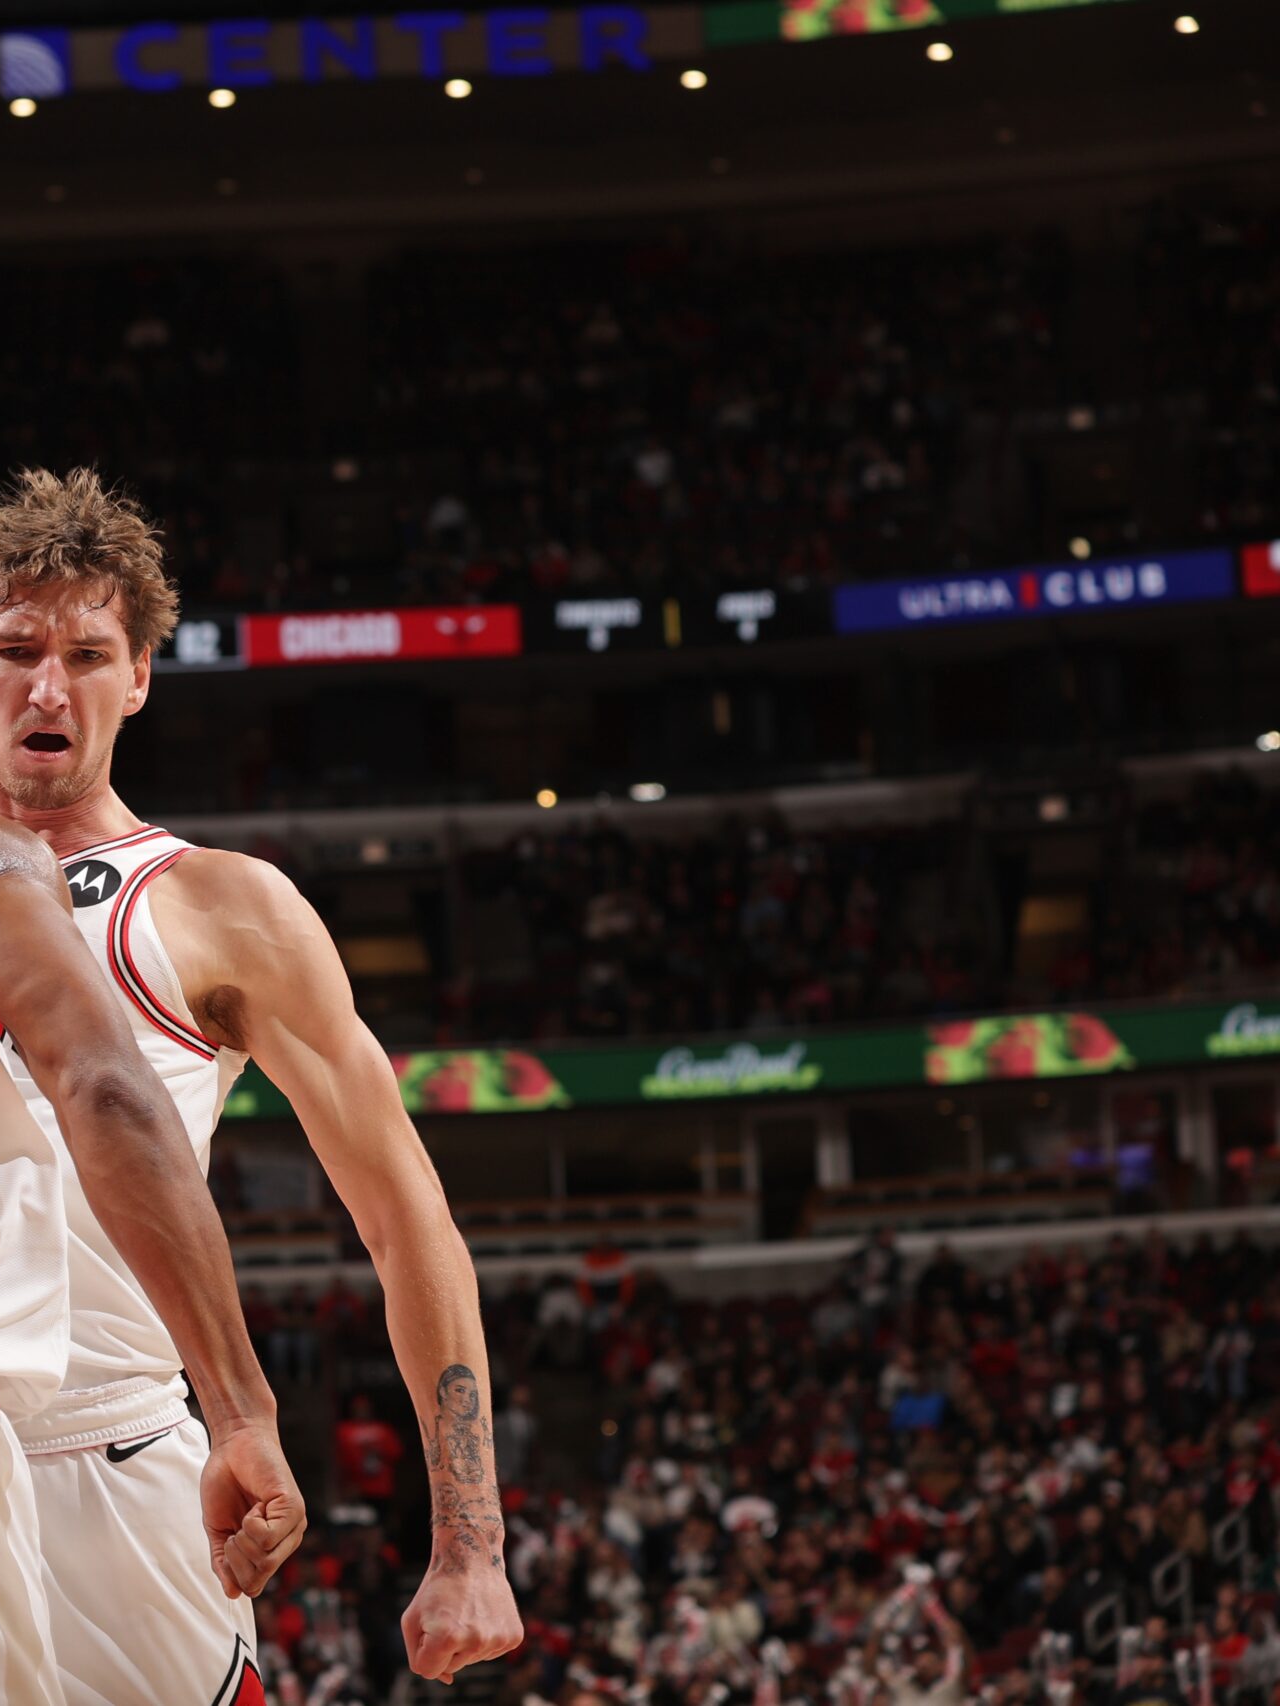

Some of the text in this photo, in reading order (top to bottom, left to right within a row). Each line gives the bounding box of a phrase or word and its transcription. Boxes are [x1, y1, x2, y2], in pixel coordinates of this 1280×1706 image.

[113, 5, 653, 92] CENTER
[897, 562, 1167, 620] ULTRA CLUB
